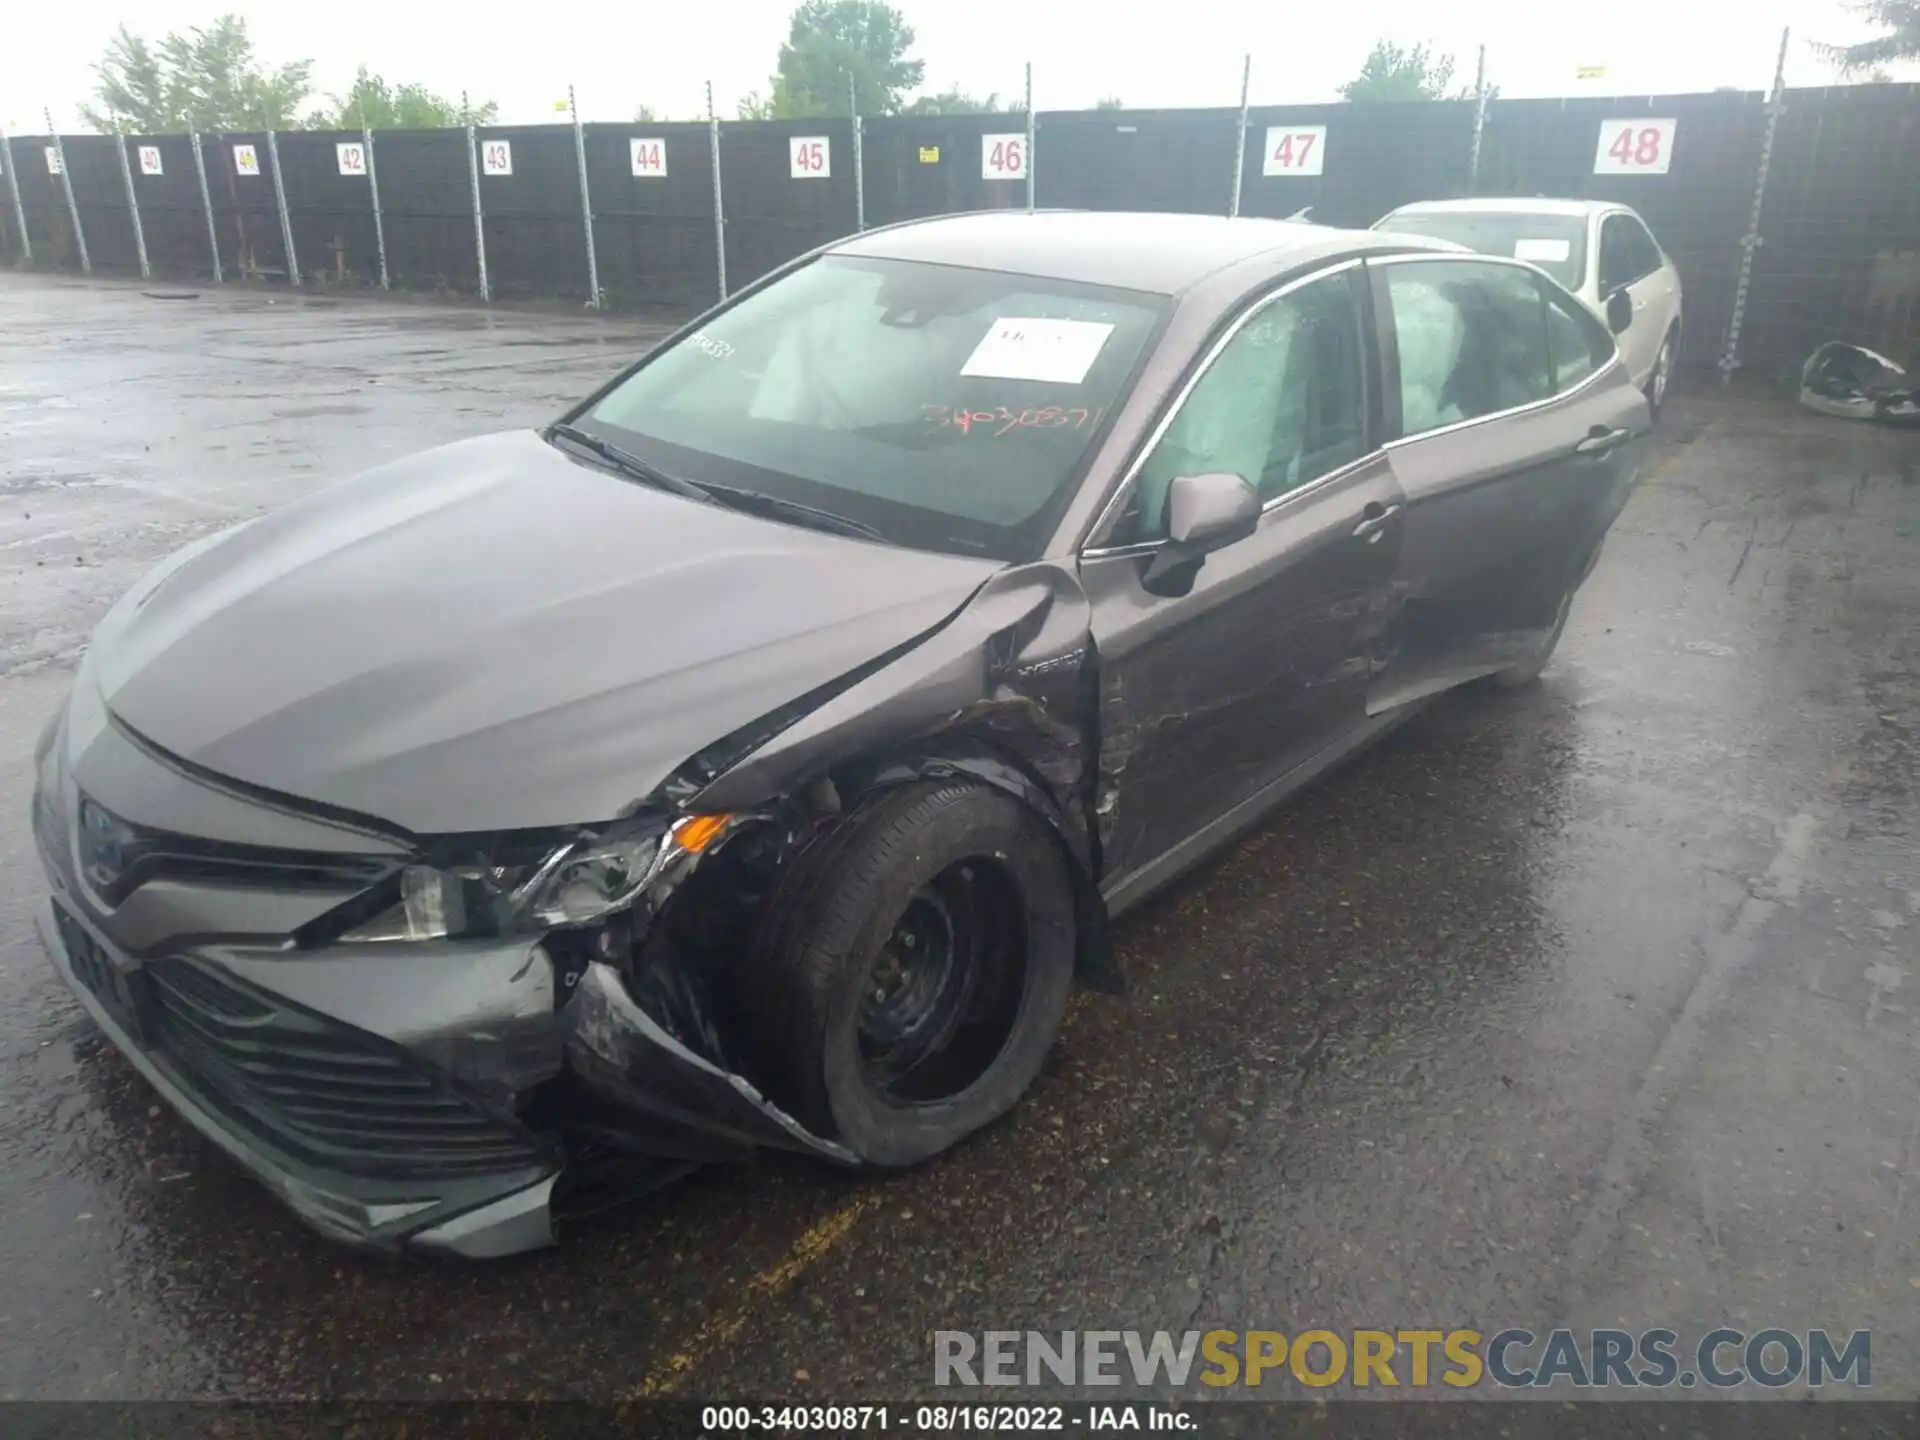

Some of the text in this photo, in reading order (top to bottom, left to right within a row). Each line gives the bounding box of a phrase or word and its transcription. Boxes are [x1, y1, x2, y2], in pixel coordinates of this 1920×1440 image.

[343, 147, 361, 170] 42
[487, 145, 508, 169] 43
[636, 143, 661, 170] 44
[796, 142, 824, 172] 45
[989, 140, 1021, 171] 46
[1273, 133, 1317, 167] 47
[1608, 127, 1661, 166] 48
